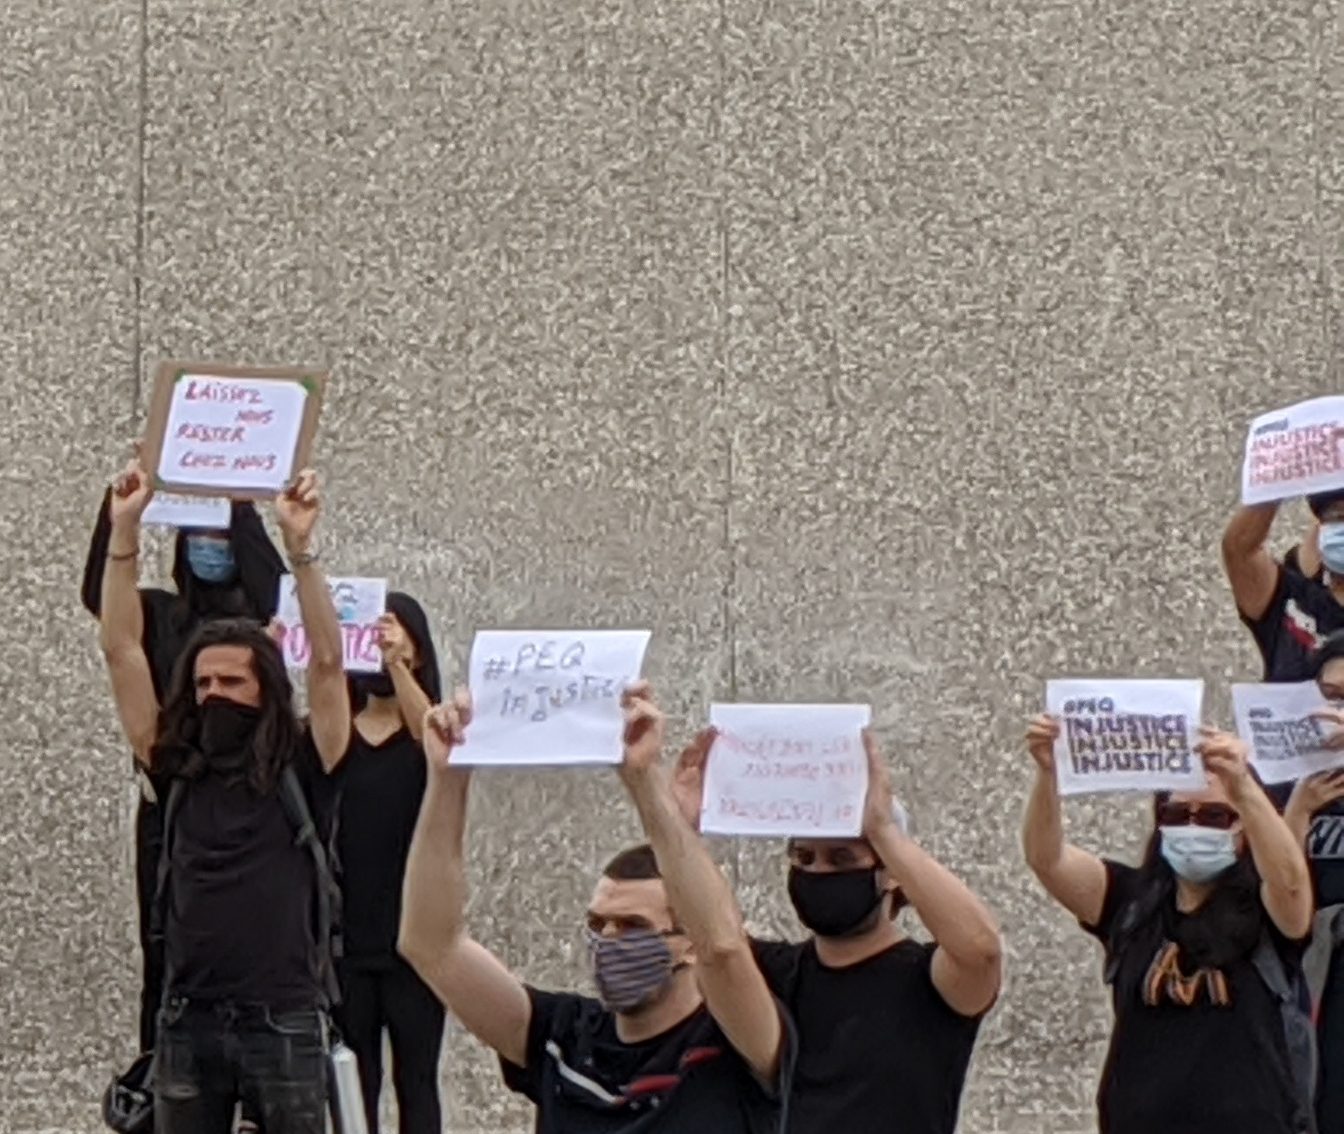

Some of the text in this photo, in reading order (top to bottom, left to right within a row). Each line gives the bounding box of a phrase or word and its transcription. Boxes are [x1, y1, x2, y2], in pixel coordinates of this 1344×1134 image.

[184, 381, 264, 404] LAISSEZ
[176, 422, 246, 443] RESTER
[1065, 714, 1187, 734] INJUSTICE
[1069, 732, 1189, 752] INJUSTICE
[1073, 752, 1193, 774] INJUSTICE
